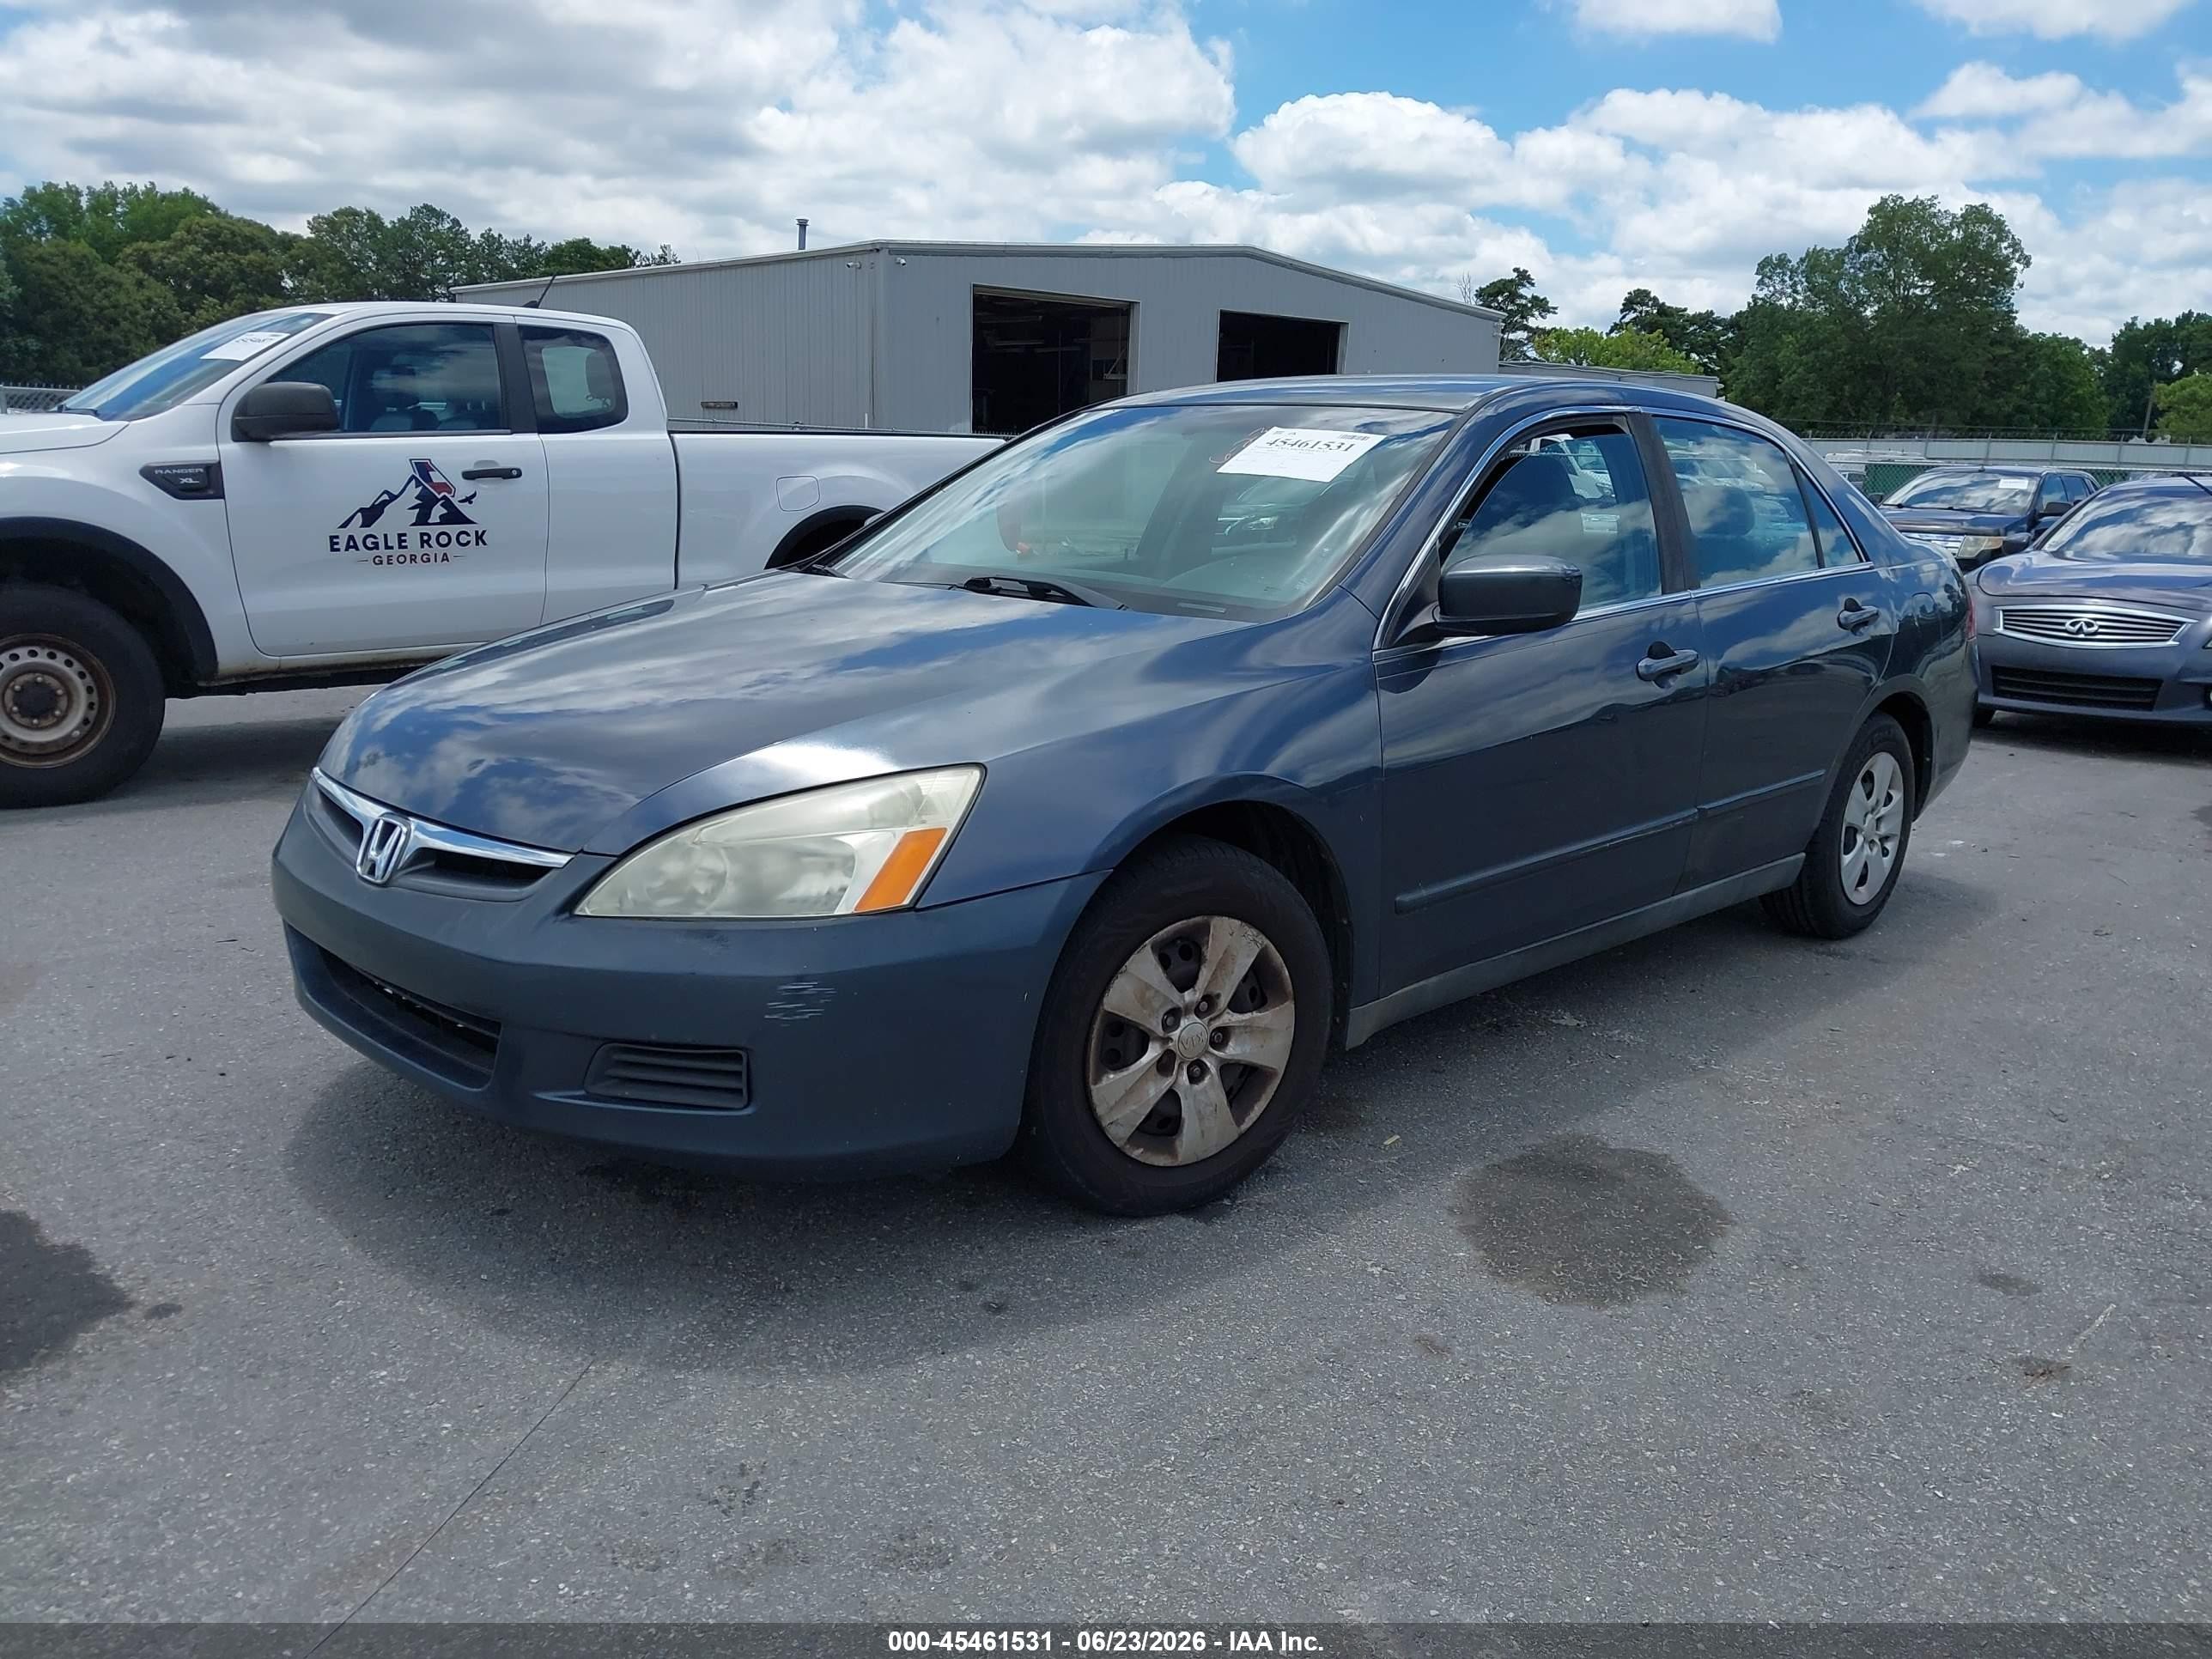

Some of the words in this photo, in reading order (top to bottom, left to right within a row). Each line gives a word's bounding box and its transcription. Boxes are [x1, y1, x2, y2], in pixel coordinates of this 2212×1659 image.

[1266, 437, 1356, 452] 45461531
[328, 532, 409, 552] EAGLE
[419, 529, 489, 550] ROCK
[373, 552, 450, 566] GEORGIA
